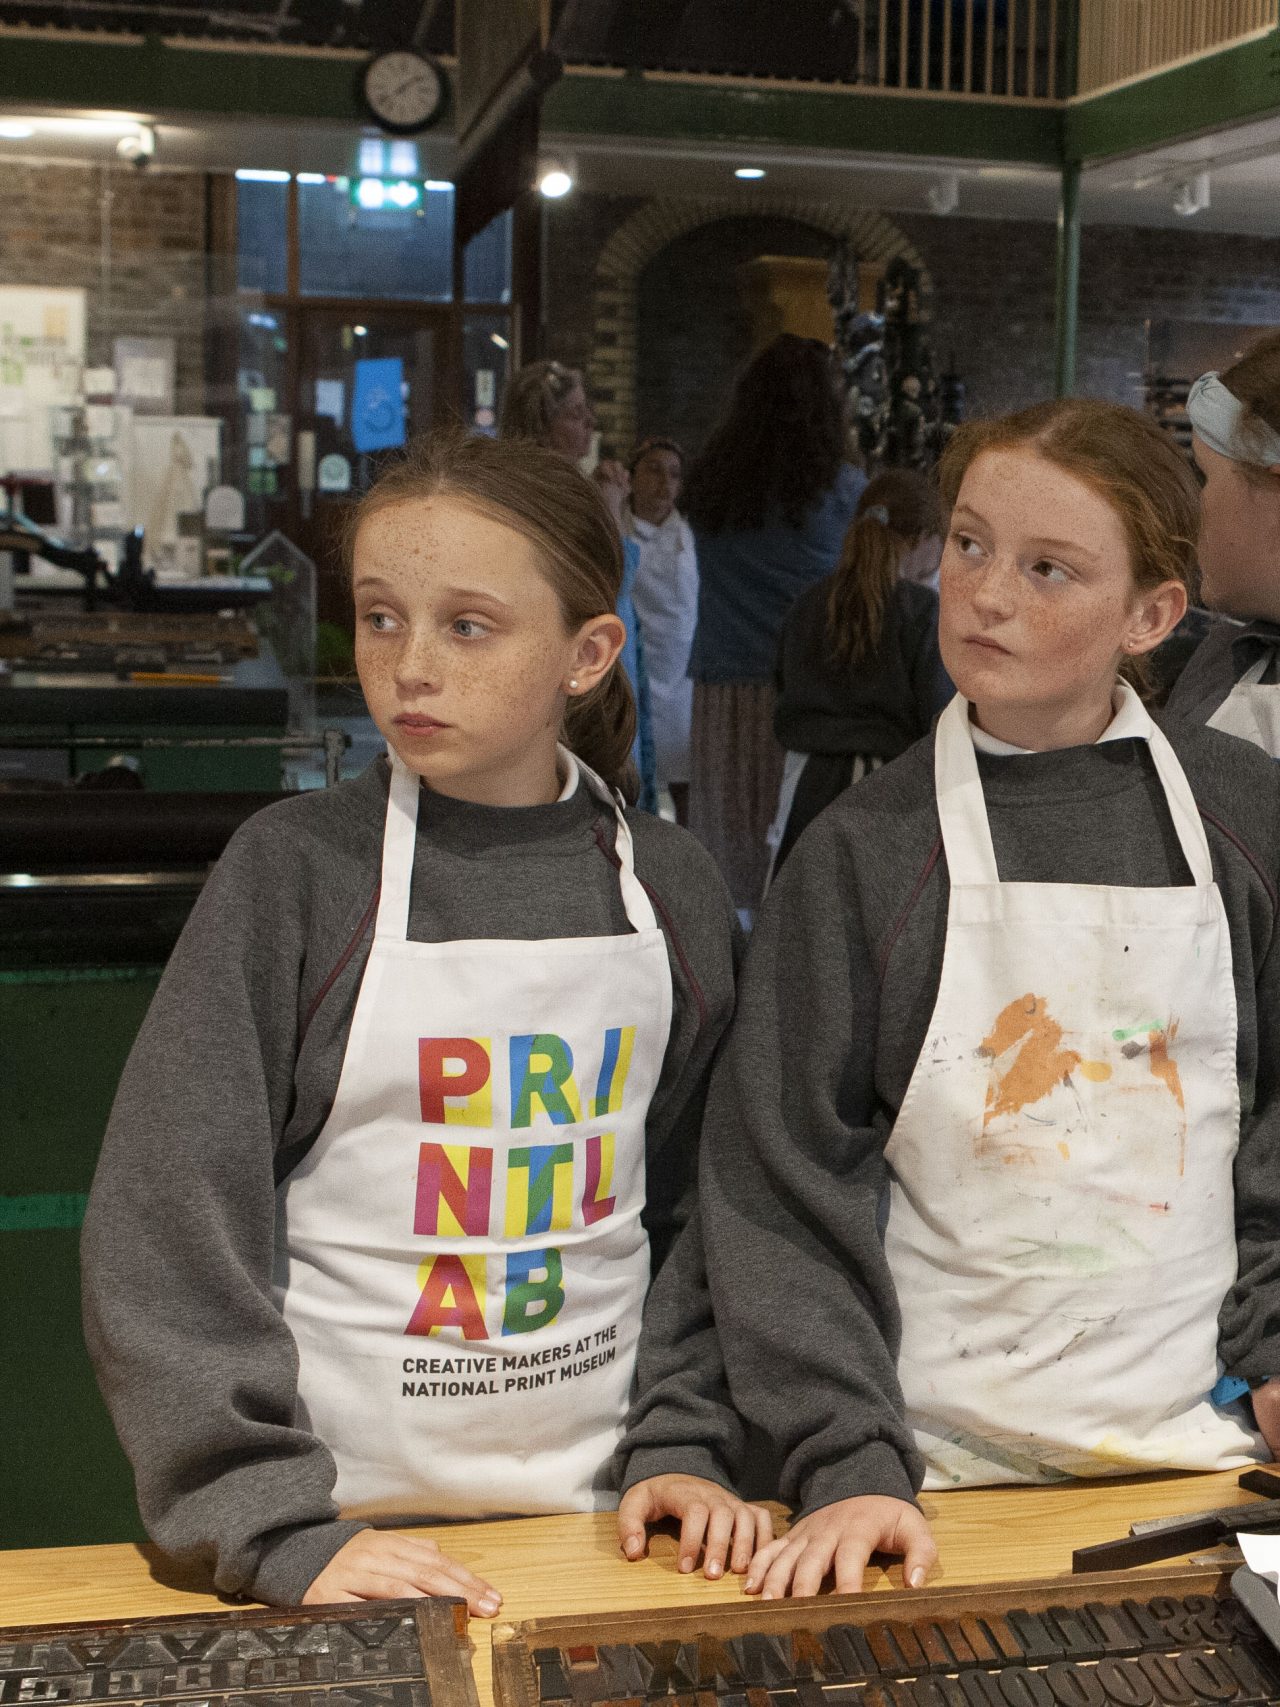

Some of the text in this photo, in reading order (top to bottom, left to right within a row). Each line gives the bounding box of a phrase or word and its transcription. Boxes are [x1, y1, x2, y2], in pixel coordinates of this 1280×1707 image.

[413, 1132, 617, 1238] NTL
[403, 1246, 566, 1341] AB
[401, 1346, 616, 1397] NATIONAL PRINT MUSEUM
[402, 1325, 617, 1374] CREATIVE MAKERS AT THE
